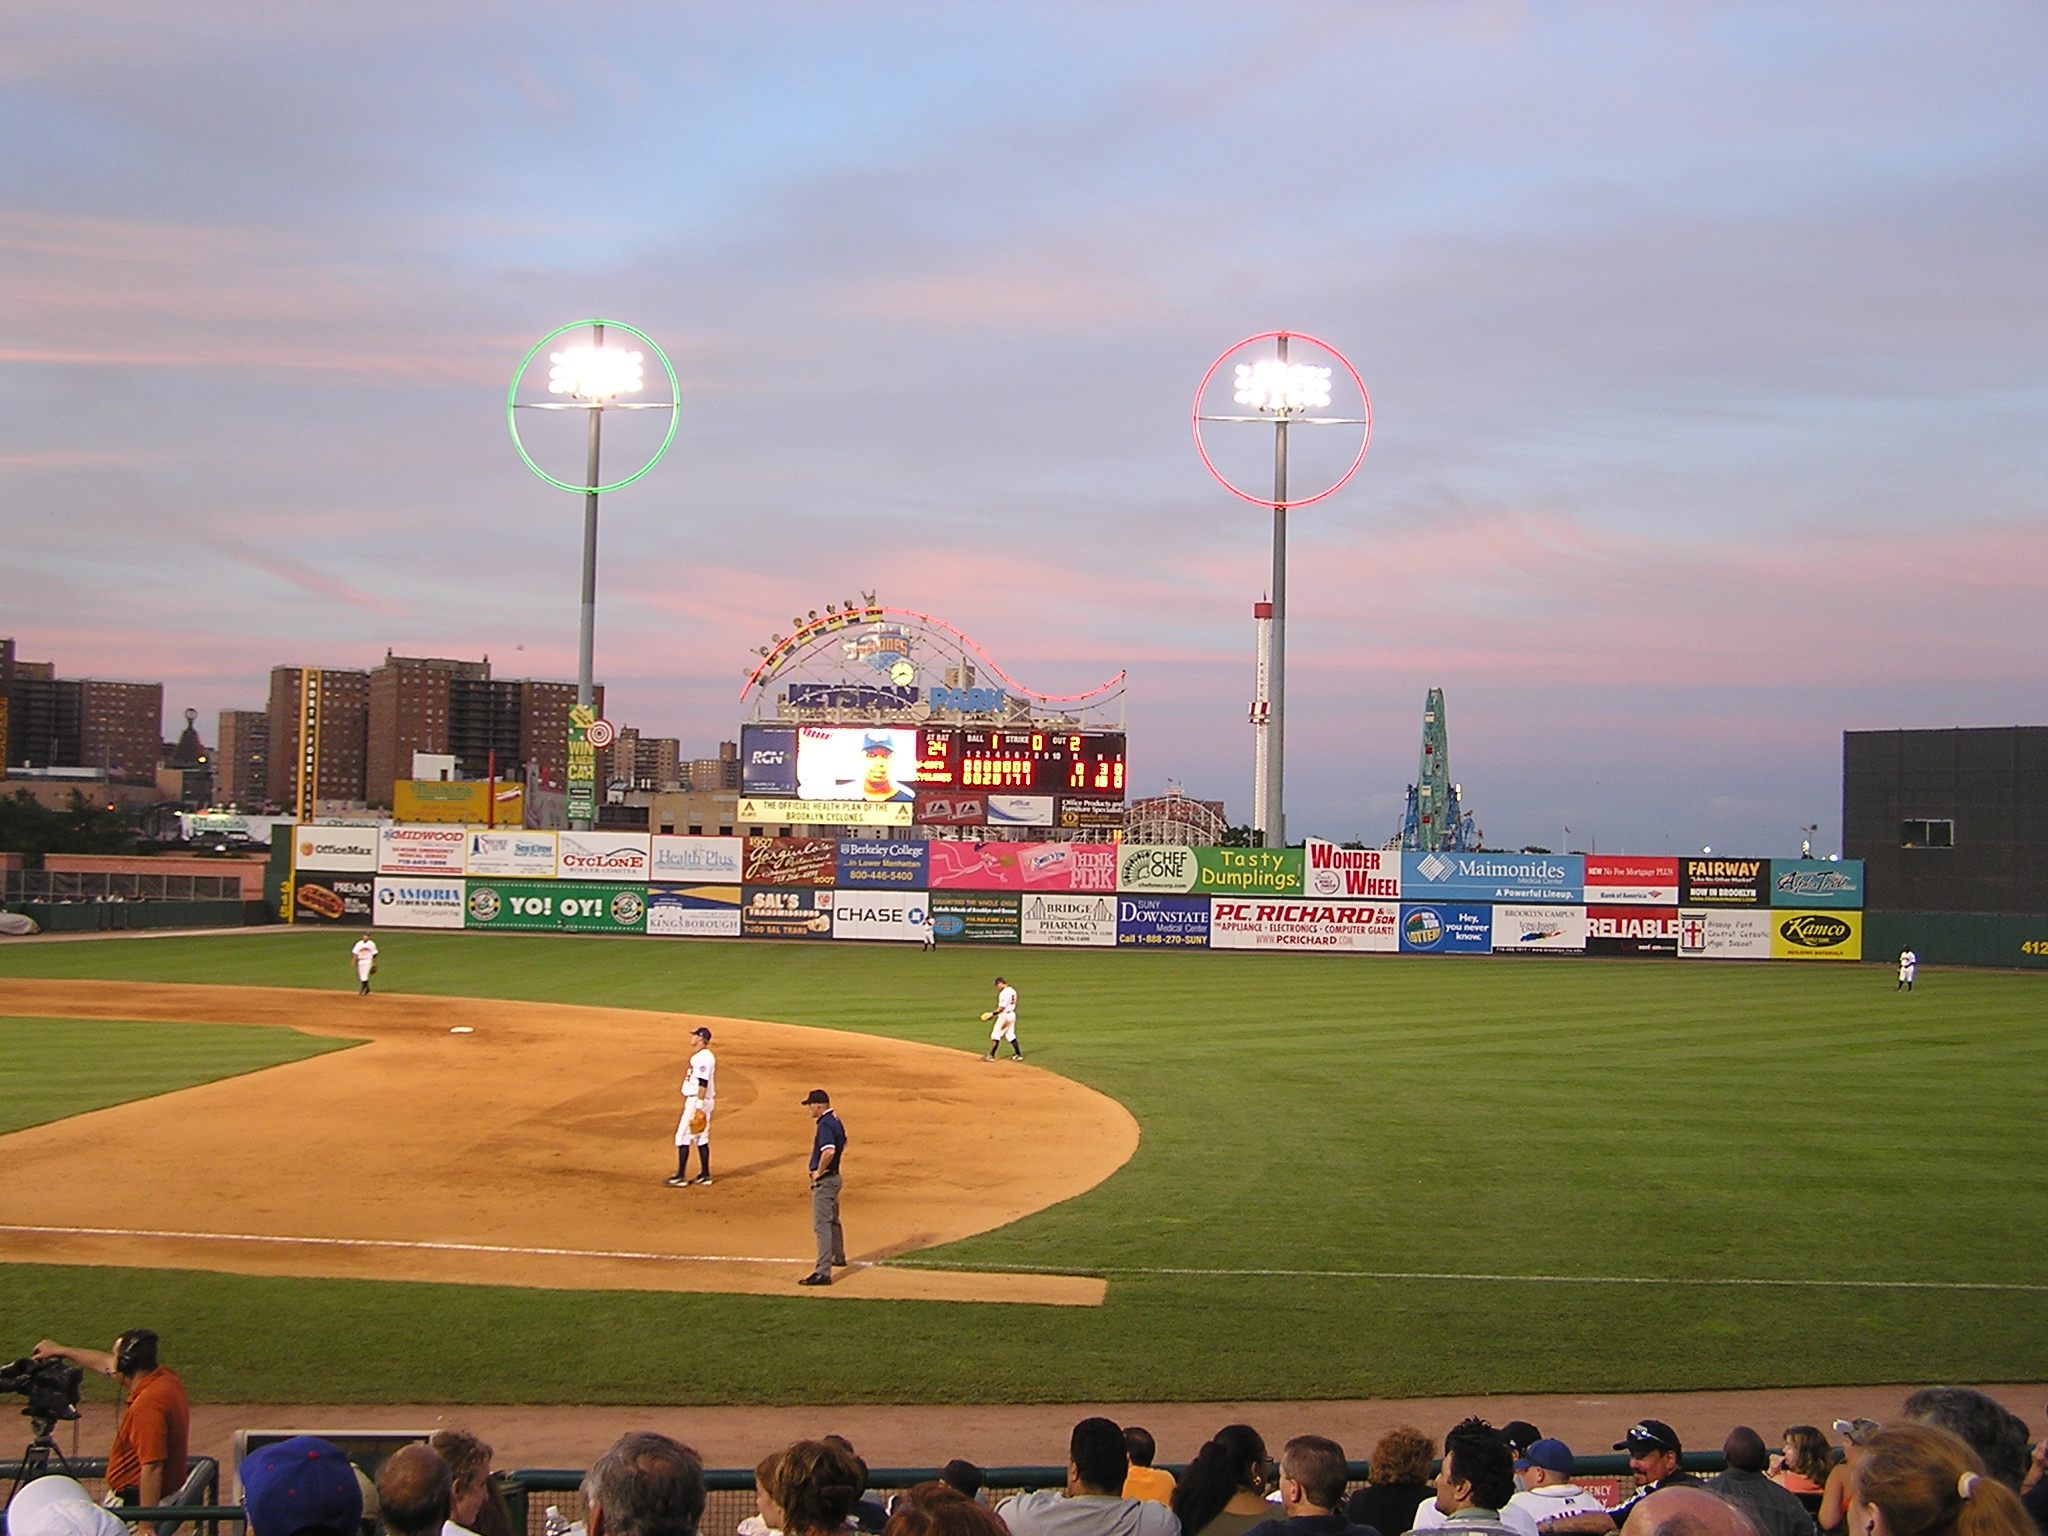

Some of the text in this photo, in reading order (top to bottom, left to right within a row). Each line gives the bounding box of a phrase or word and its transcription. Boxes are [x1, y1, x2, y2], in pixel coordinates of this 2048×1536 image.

[930, 687, 1006, 712] PARK
[568, 741, 594, 755] WIN
[966, 734, 998, 749] BALL 1
[1005, 734, 1043, 751] STRIKE 0
[1052, 736, 1081, 751] OUT 2
[927, 741, 947, 757] 24
[752, 750, 784, 765] RCN
[568, 764, 594, 780] CAR
[763, 801, 889, 812] THE OFFICIAL HEALTH PLAN OF THE
[786, 811, 824, 821] BROOKLYN
[394, 830, 464, 842] MIDWOOD
[315, 844, 373, 856] OfficeMax
[658, 848, 734, 866] Health Plus
[850, 843, 924, 858] Berkeley College
[1311, 844, 1381, 870] WONDER
[882, 860, 921, 868] Manhattan
[1070, 851, 1115, 868] THINK
[1151, 851, 1188, 865] CHEF
[1220, 850, 1284, 872] Tasty
[1151, 864, 1184, 878] ONE
[1458, 859, 1565, 878] Maimonides
[1603, 868, 1612, 876] No
[1614, 868, 1625, 876] Fee
[1626, 868, 1655, 878] Mortgage
[1656, 868, 1674, 876] PLUS
[1688, 861, 1760, 877] FAIRWAY
[1069, 866, 1115, 889] PINK
[1345, 870, 1399, 897] WHEEL
[1517, 877, 1564, 885] Medical Center
[399, 888, 460, 901] ASTORIA
[1495, 889, 1574, 900] A Powerful Lineup.
[1690, 888, 1756, 897] NOW IN BROOKLYN
[509, 897, 551, 915] YO!
[560, 898, 603, 917] OY!
[753, 892, 800, 909] SAL'S
[1138, 900, 1161, 909] SUNY
[749, 908, 820, 918] TRANSMISSIONS
[836, 907, 903, 922] CHASE
[1047, 903, 1093, 913] BRIDGE
[1121, 901, 1208, 923] DOWNSTATE
[1214, 903, 1375, 925] P.C. RICHARD
[1504, 910, 1575, 918] BROOKLYN CAMPUS
[650, 915, 738, 929] KINGSBOROUGH
[1039, 921, 1099, 931] PHARMACY
[1374, 915, 1396, 925] SON
[1156, 923, 1208, 933] Medical Center
[1221, 923, 1394, 936] APPLIANCE ELECTRONICS COMPUTER GIANT!
[1445, 924, 1490, 933] you never
[1586, 918, 1678, 939] RELIABLE
[1786, 917, 1846, 945] Kamco
[1119, 934, 1135, 943] Call
[2021, 941, 2048, 955] 412
